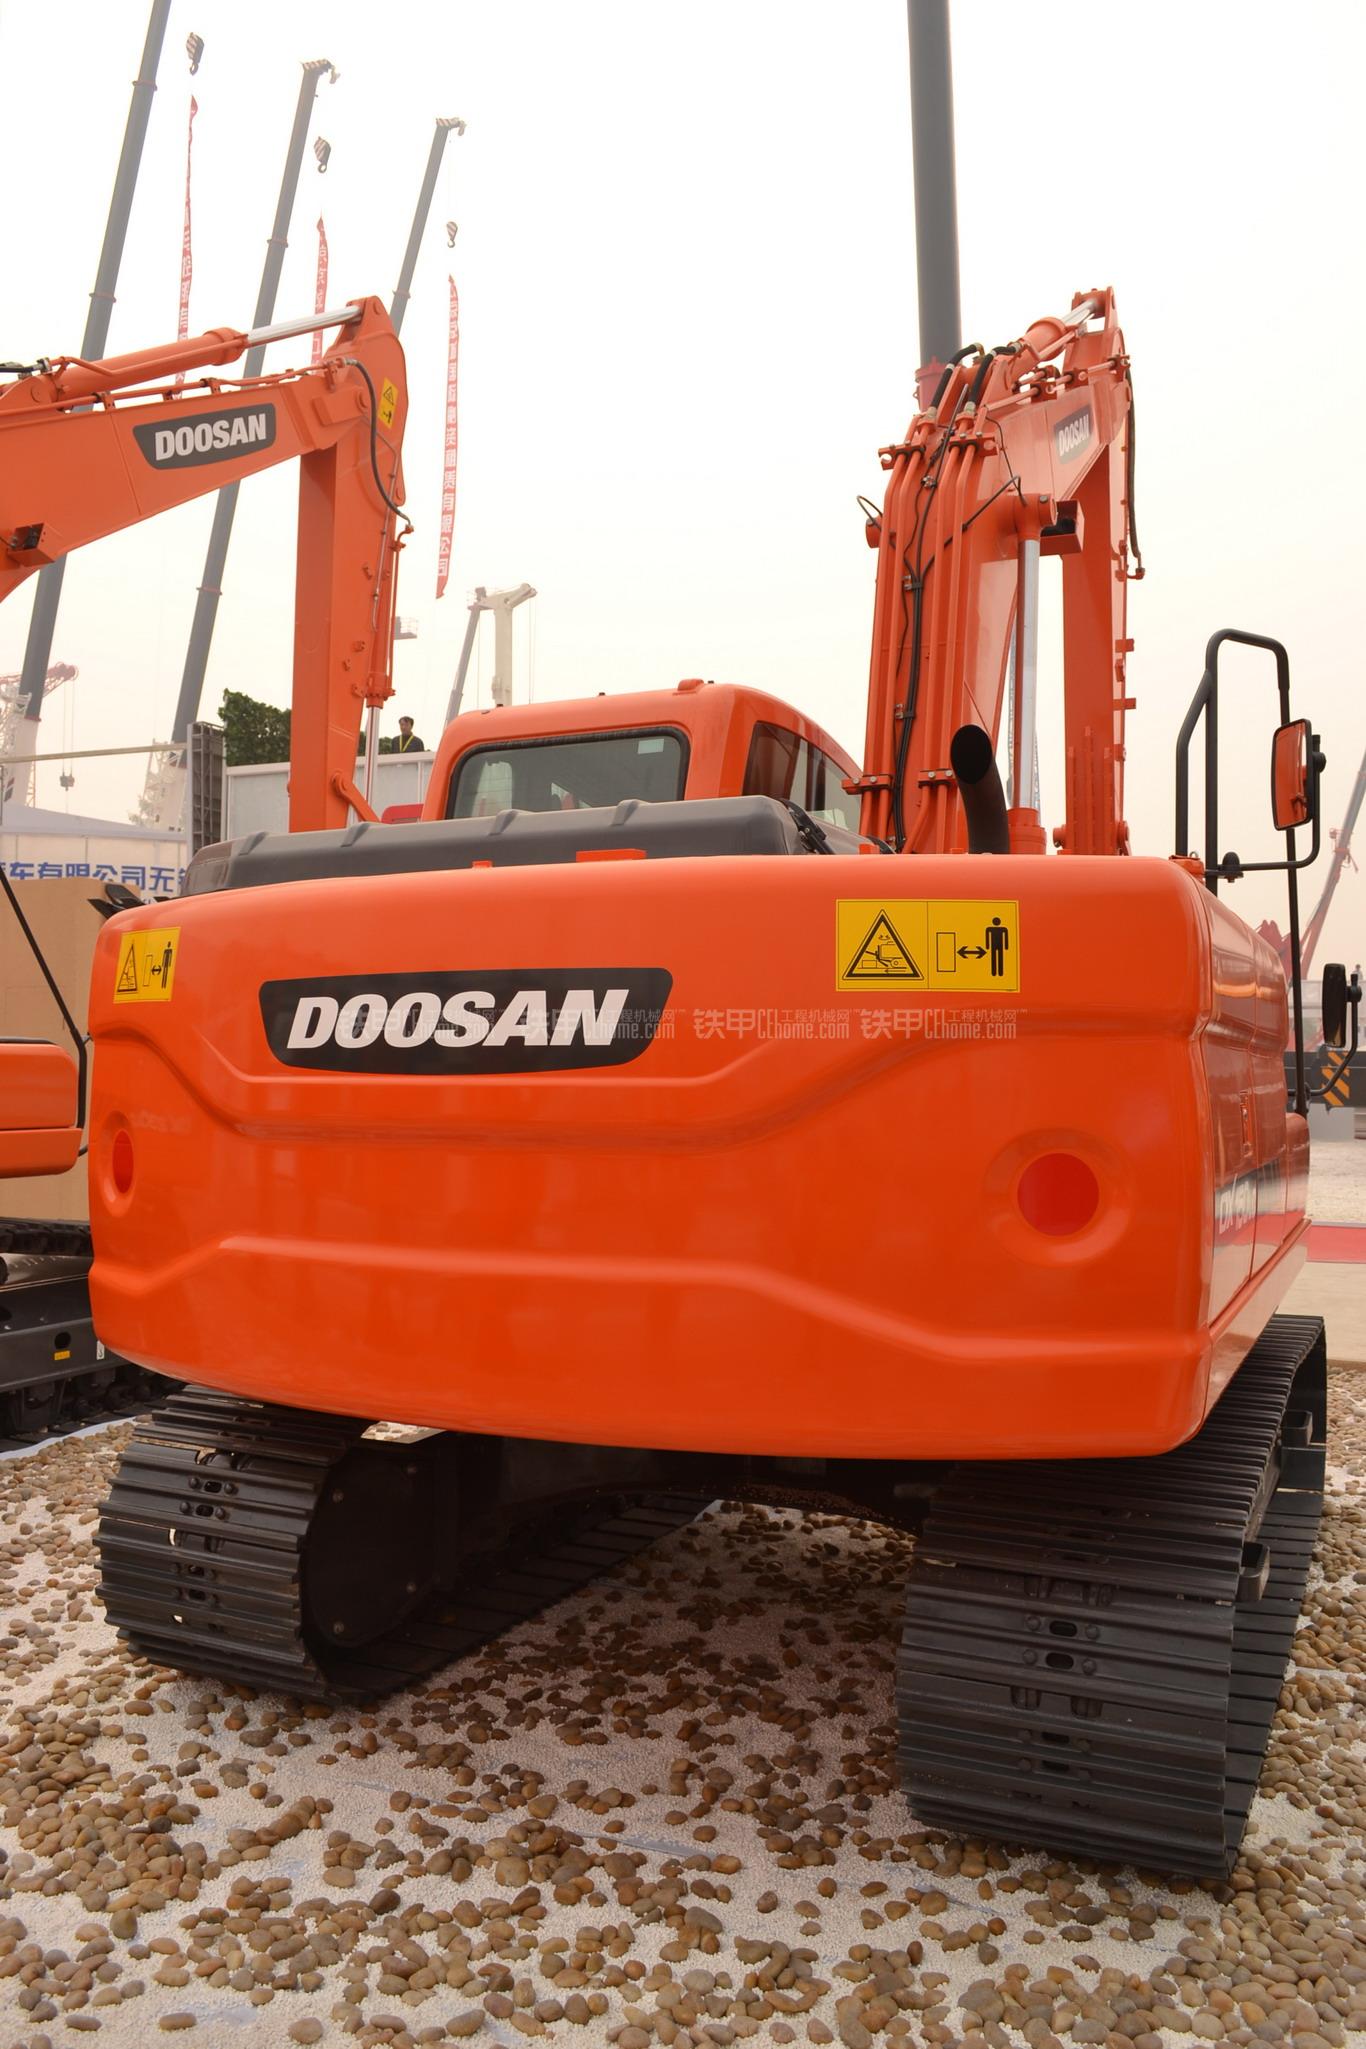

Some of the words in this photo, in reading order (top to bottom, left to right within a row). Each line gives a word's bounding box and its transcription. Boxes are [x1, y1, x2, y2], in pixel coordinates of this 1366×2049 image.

[155, 413, 267, 461] DOOSAN
[1058, 414, 1089, 457] DOOSAN
[286, 989, 629, 1049] DOOSAN
